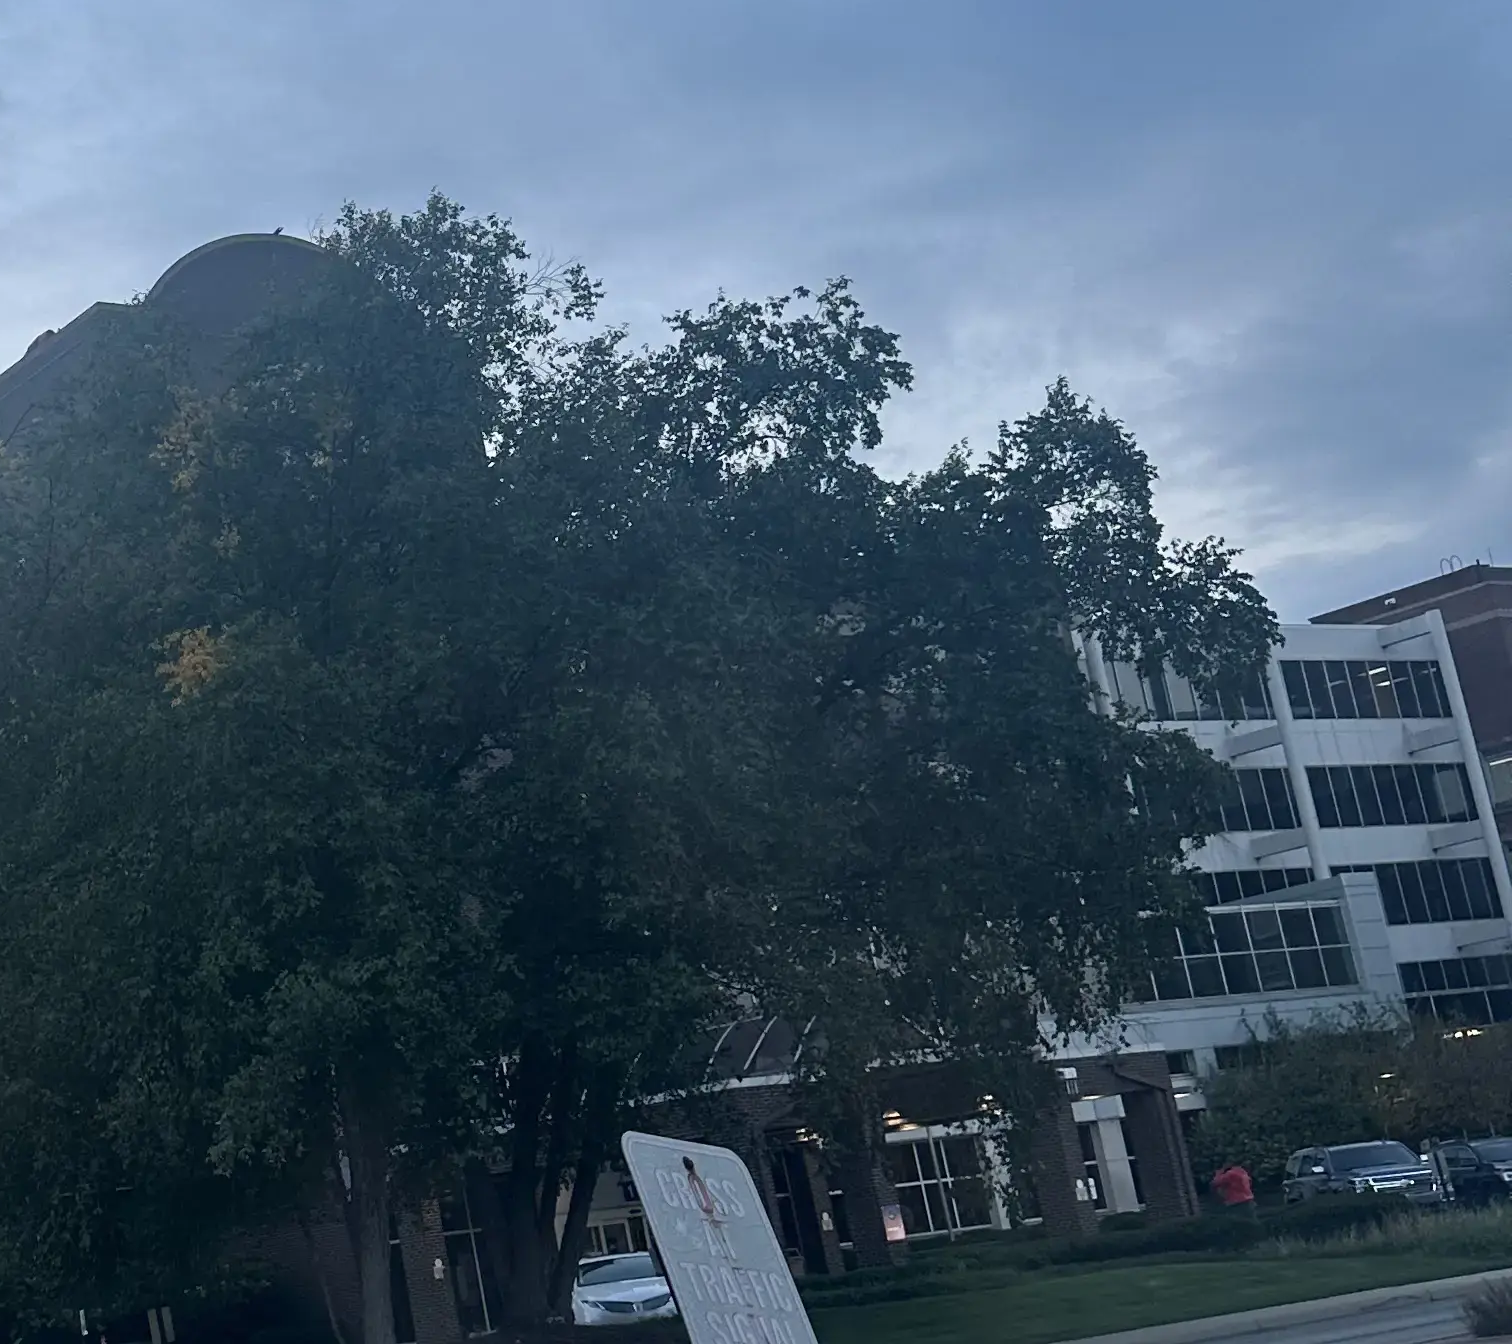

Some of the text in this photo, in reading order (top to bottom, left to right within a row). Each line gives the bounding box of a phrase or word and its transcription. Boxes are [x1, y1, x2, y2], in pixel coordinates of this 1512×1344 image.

[656, 1168, 746, 1218] CROSS
[701, 1218, 737, 1260] AT
[681, 1262, 792, 1312] TRAFFIC
